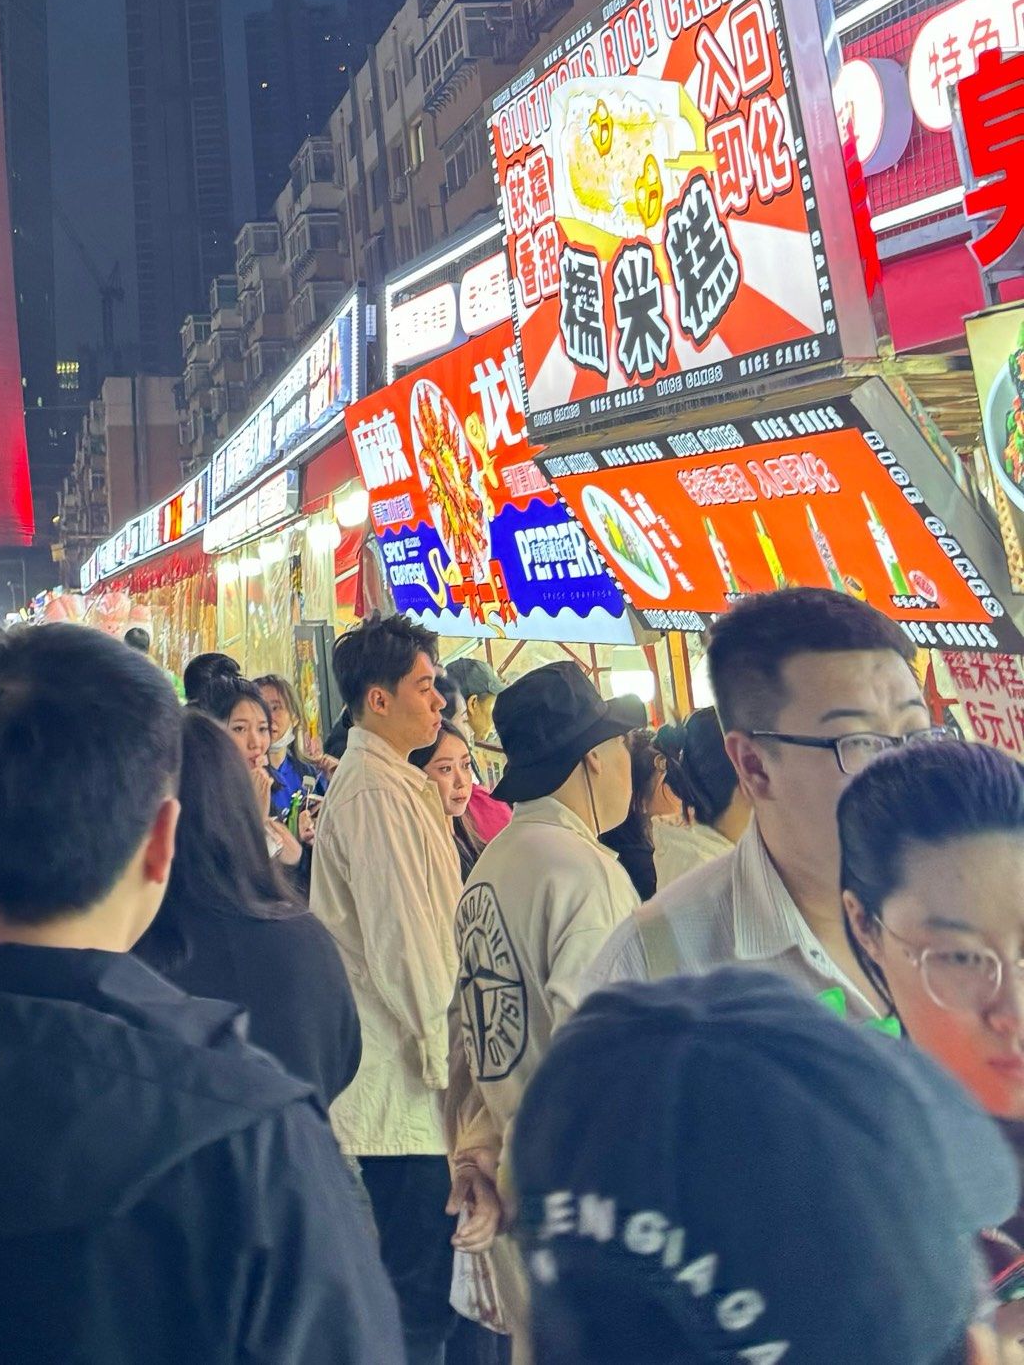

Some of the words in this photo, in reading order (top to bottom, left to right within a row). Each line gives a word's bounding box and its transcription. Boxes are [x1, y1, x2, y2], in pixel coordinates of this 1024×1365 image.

[506, 149, 555, 235] 软糯
[707, 93, 792, 213] 即化
[516, 222, 559, 307] 香甜
[560, 175, 740, 376] 糯米糕
[740, 357, 769, 376] RICE
[776, 341, 820, 365] CAKES
[352, 408, 412, 491] 麻辣
[900, 621, 937, 644] ICE
